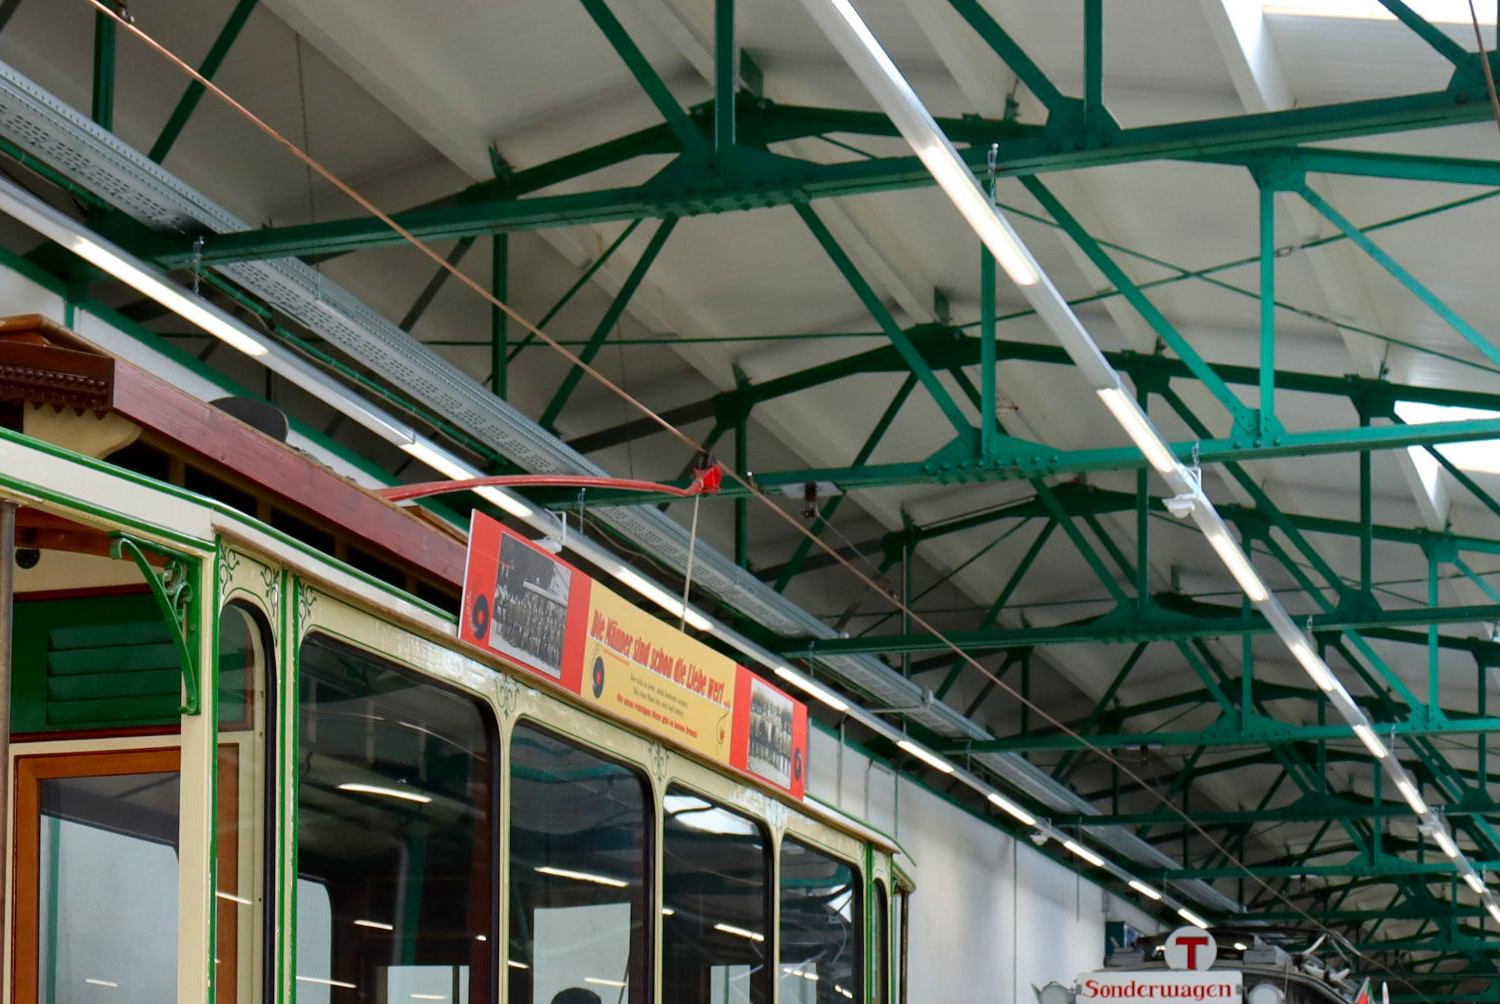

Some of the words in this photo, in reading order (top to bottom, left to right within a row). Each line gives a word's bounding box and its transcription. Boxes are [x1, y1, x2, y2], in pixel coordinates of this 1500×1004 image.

[590, 609, 605, 641] Die
[632, 636, 651, 667] sind
[650, 647, 674, 679] schon
[673, 656, 687, 685] die
[686, 663, 707, 695] Liebe
[1175, 936, 1209, 970] T
[1085, 979, 1232, 1001] Sonderwagen
